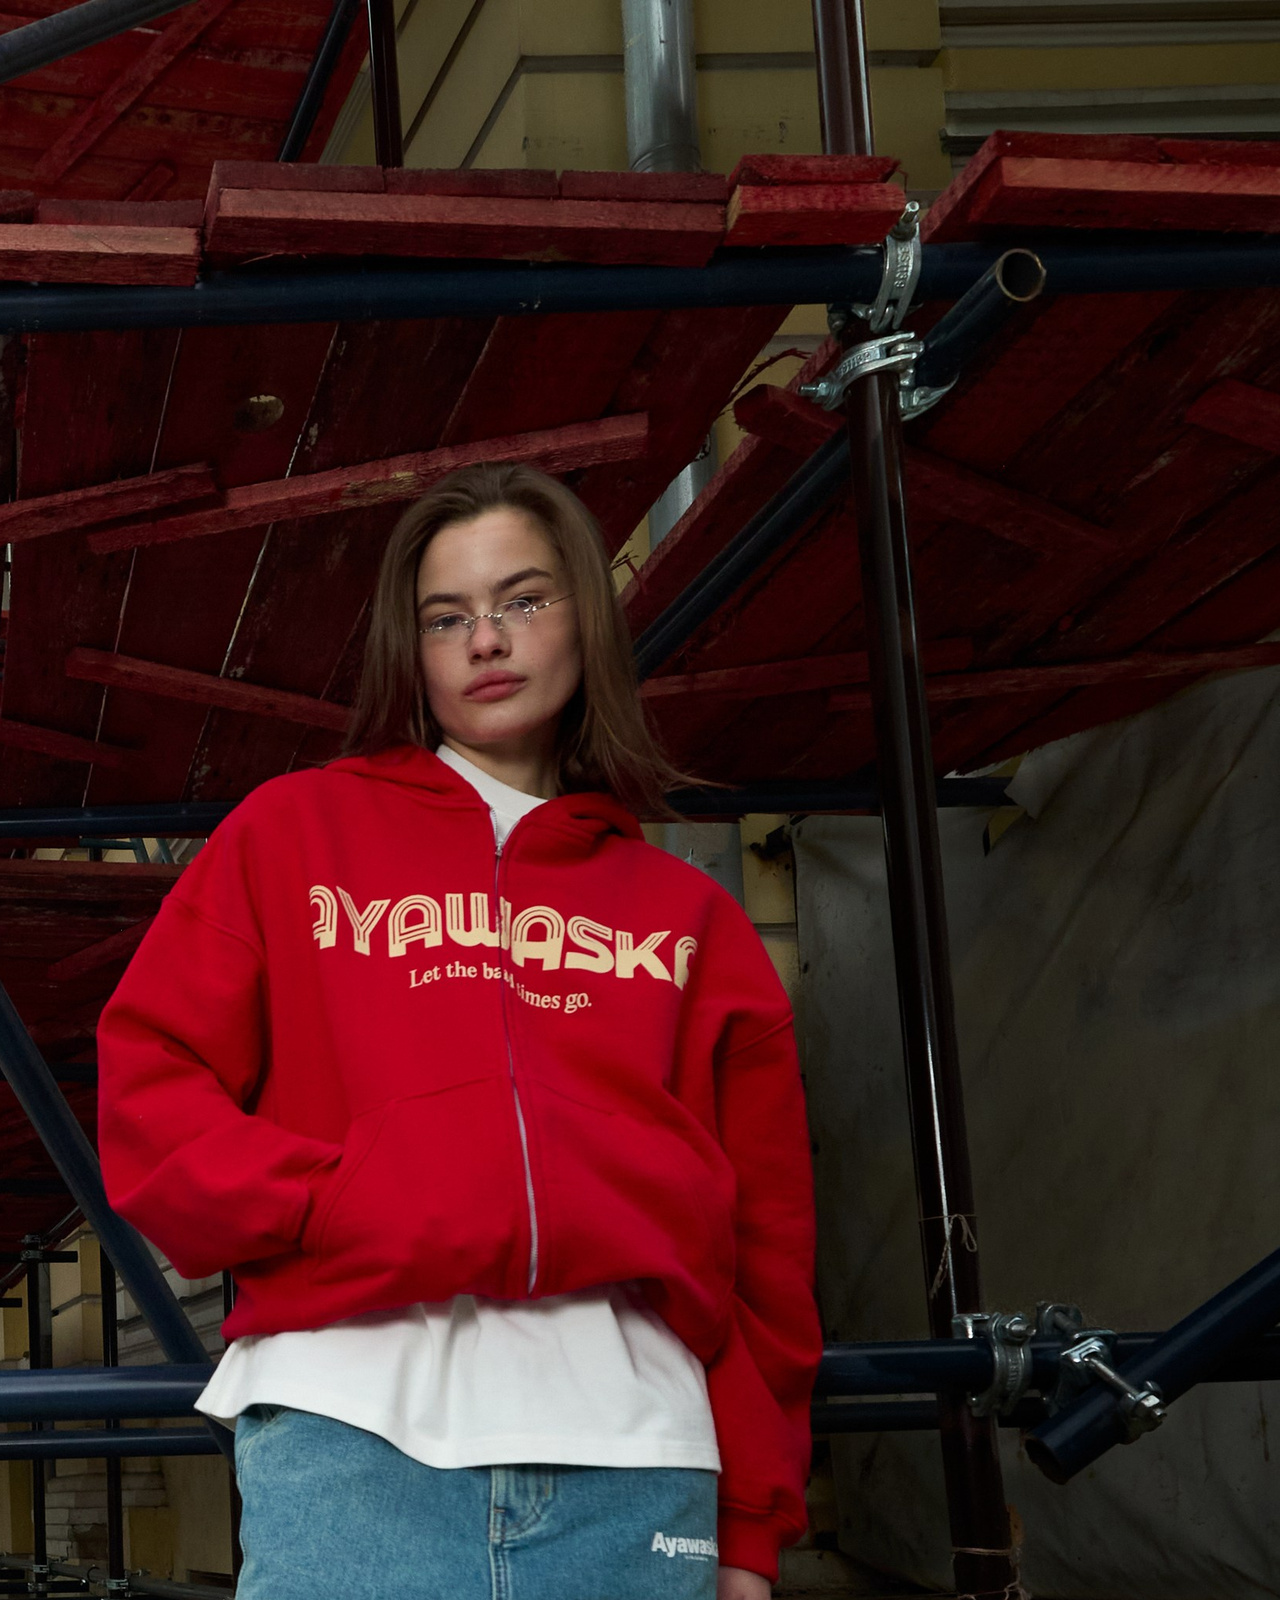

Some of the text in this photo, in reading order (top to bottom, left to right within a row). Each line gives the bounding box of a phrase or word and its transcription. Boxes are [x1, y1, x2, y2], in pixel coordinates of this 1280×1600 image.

[409, 965, 442, 989] Let
[446, 960, 478, 979] the
[516, 982, 561, 1010] times
[564, 991, 593, 1014] go.
[651, 1531, 719, 1558] Ayawask
